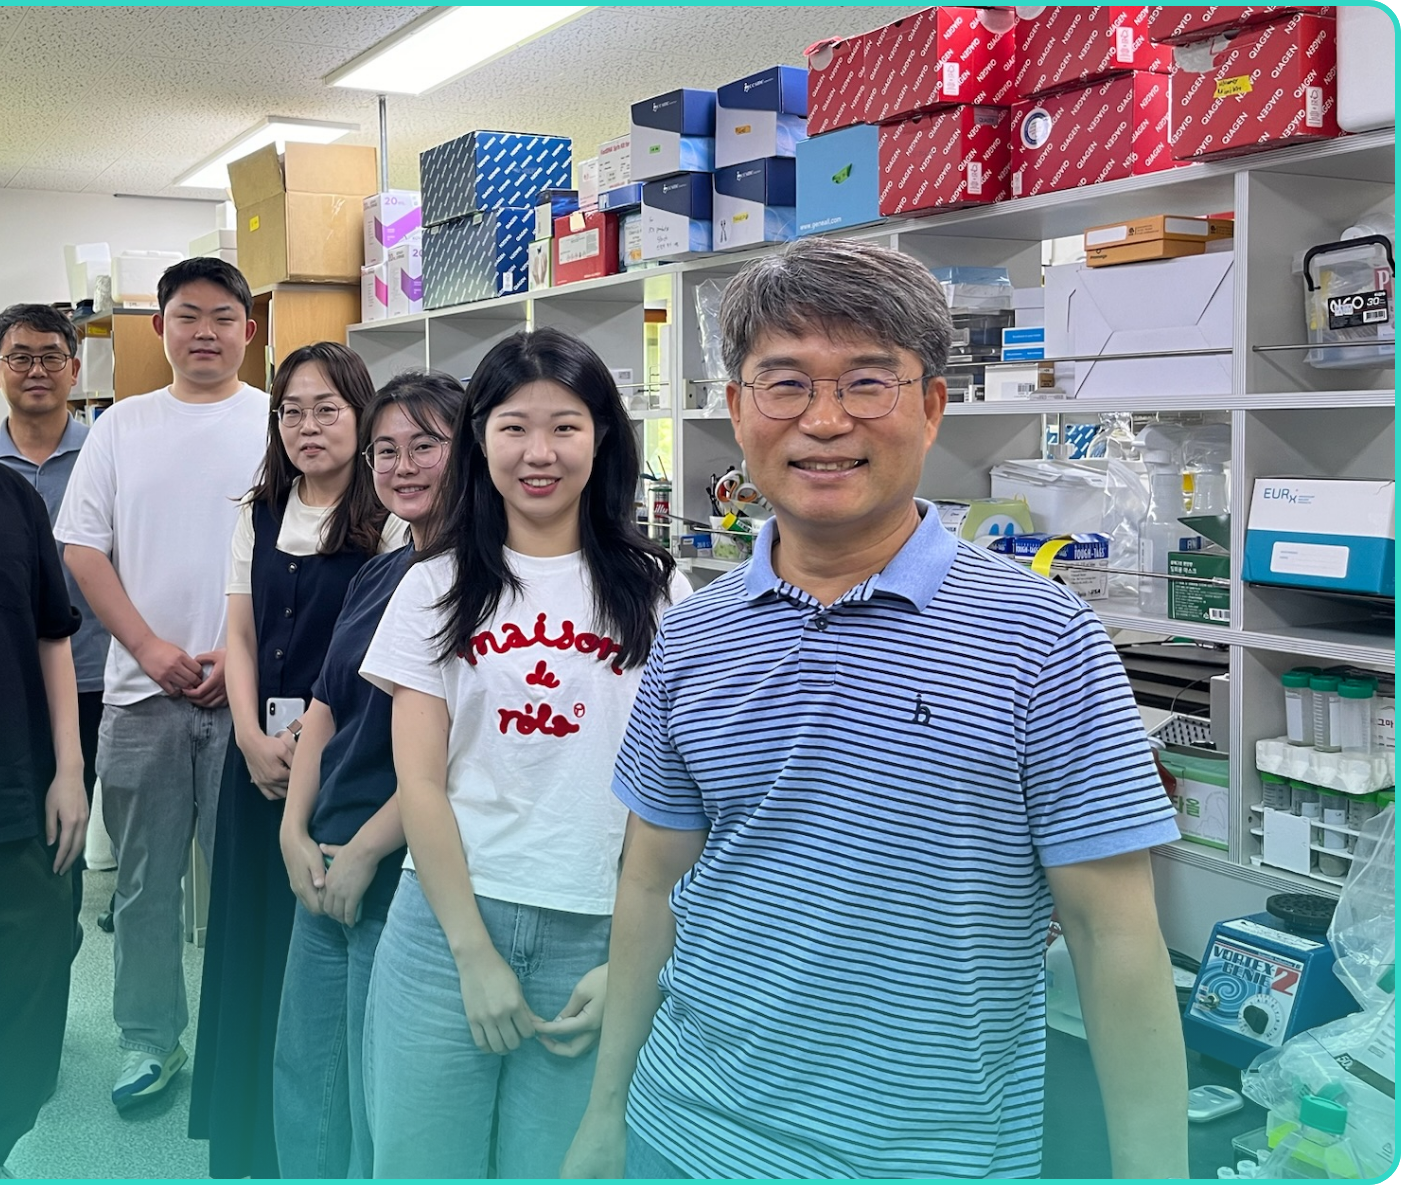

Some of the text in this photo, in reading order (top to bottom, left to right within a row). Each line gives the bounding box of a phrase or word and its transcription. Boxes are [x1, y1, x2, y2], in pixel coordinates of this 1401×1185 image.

[908, 14, 923, 42] QIAGEN
[943, 17, 963, 40] QIAGEN
[1022, 22, 1040, 51] QIAGEN
[1062, 14, 1081, 44] QIAGEN
[888, 35, 903, 61] QIAGEN
[921, 30, 937, 57] QIAGEN
[960, 38, 980, 61] QIAGEN
[1037, 37, 1056, 66] QIAGEN
[1078, 30, 1098, 60] QIAGEN
[1249, 25, 1275, 59] QIAGEN
[1305, 30, 1326, 58] QIAGEN
[870, 55, 883, 80] QIAGEN
[900, 49, 915, 76] QIAGEN
[977, 59, 997, 82] QIAGEN
[1053, 52, 1072, 82] QIAGEN
[1271, 44, 1298, 79] QIAGEN
[881, 69, 896, 95] QIAGEN
[913, 65, 928, 92] QIAGEN
[993, 80, 1012, 103] QIAGEN
[1181, 74, 1205, 106] QIAGEN
[894, 85, 908, 110] QIAGEN
[1071, 88, 1092, 116] QIAGEN
[1140, 85, 1159, 109] QIAGEN
[1257, 89, 1284, 122] QIAGEN
[928, 113, 946, 139] QIAGEN
[1087, 104, 1109, 133] QIAGEN
[1222, 112, 1248, 144] QIAGEN
[906, 131, 923, 156] QIAGEN
[943, 128, 961, 155] QIAGEN
[1060, 123, 1081, 152] QIAGEN
[1105, 121, 1127, 150] QIAGEN
[885, 149, 901, 174] QIAGEN
[920, 147, 937, 173] QIAGEN
[1034, 142, 1053, 170] QIAGEN
[1077, 141, 1097, 170] QIAGEN
[1145, 142, 1164, 166] QIAGEN
[898, 164, 914, 189] QIAGEN
[934, 163, 951, 189] QIAGEN
[1050, 160, 1070, 187] QIAGEN
[912, 180, 929, 205] QIAGEN
[456, 612, 624, 676] maison
[525, 660, 561, 689] de
